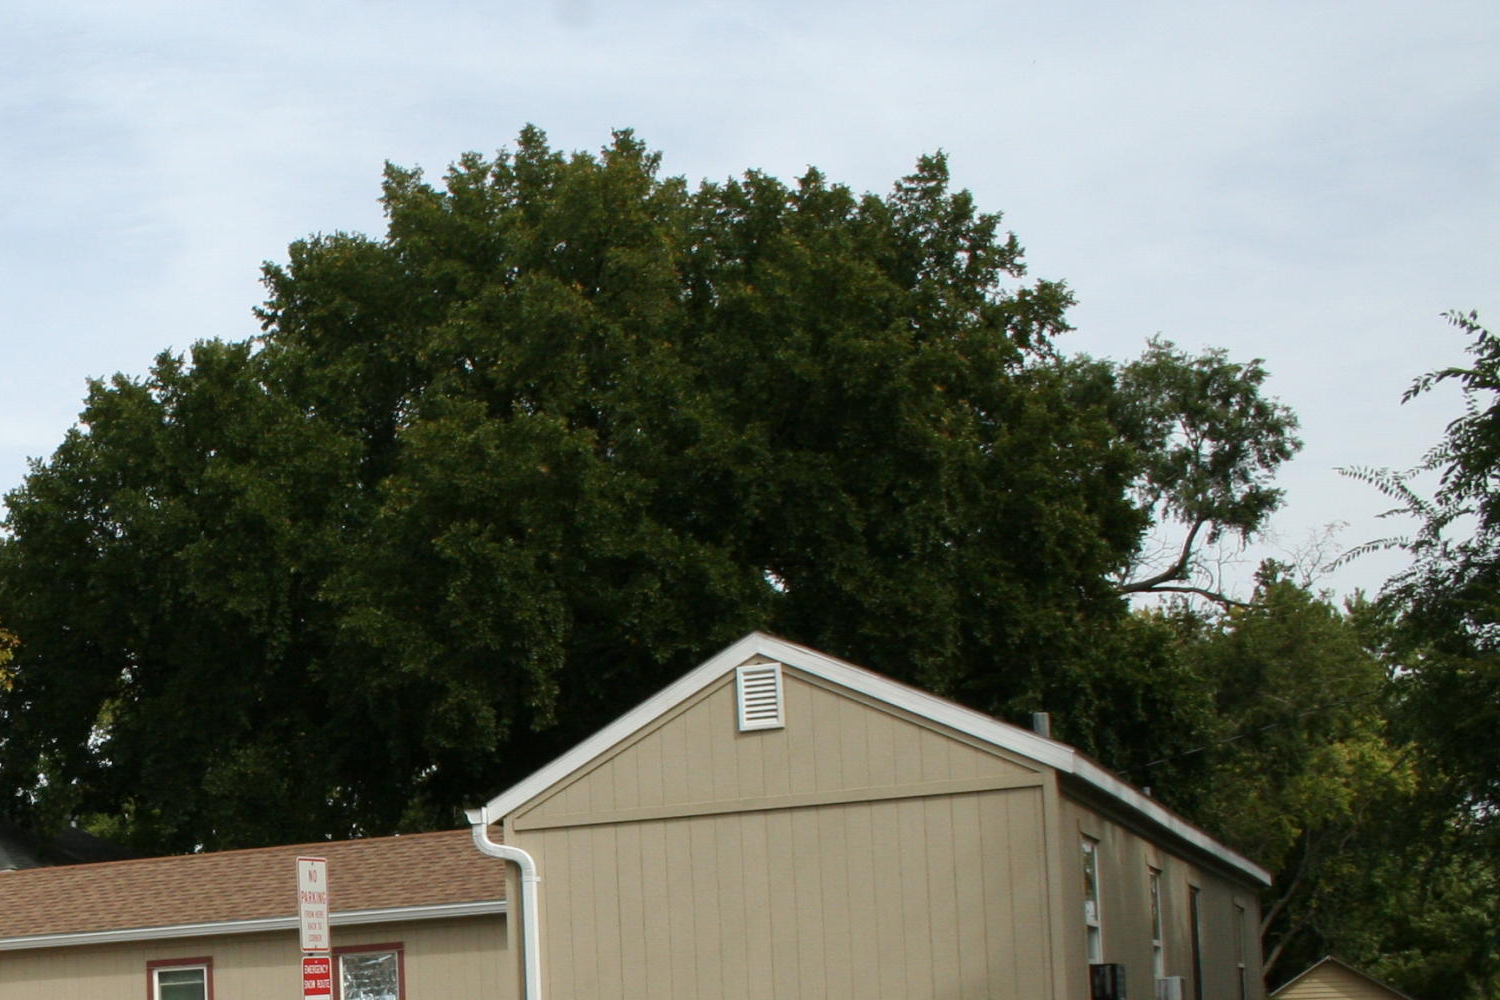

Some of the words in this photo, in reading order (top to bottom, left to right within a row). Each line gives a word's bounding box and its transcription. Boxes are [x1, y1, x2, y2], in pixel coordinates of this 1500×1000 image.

[308, 869, 318, 883] NO
[301, 891, 326, 904] PARKING
[304, 964, 328, 974] EMERGENCY
[304, 980, 316, 989] SNOW
[317, 979, 330, 988] ROUTE
